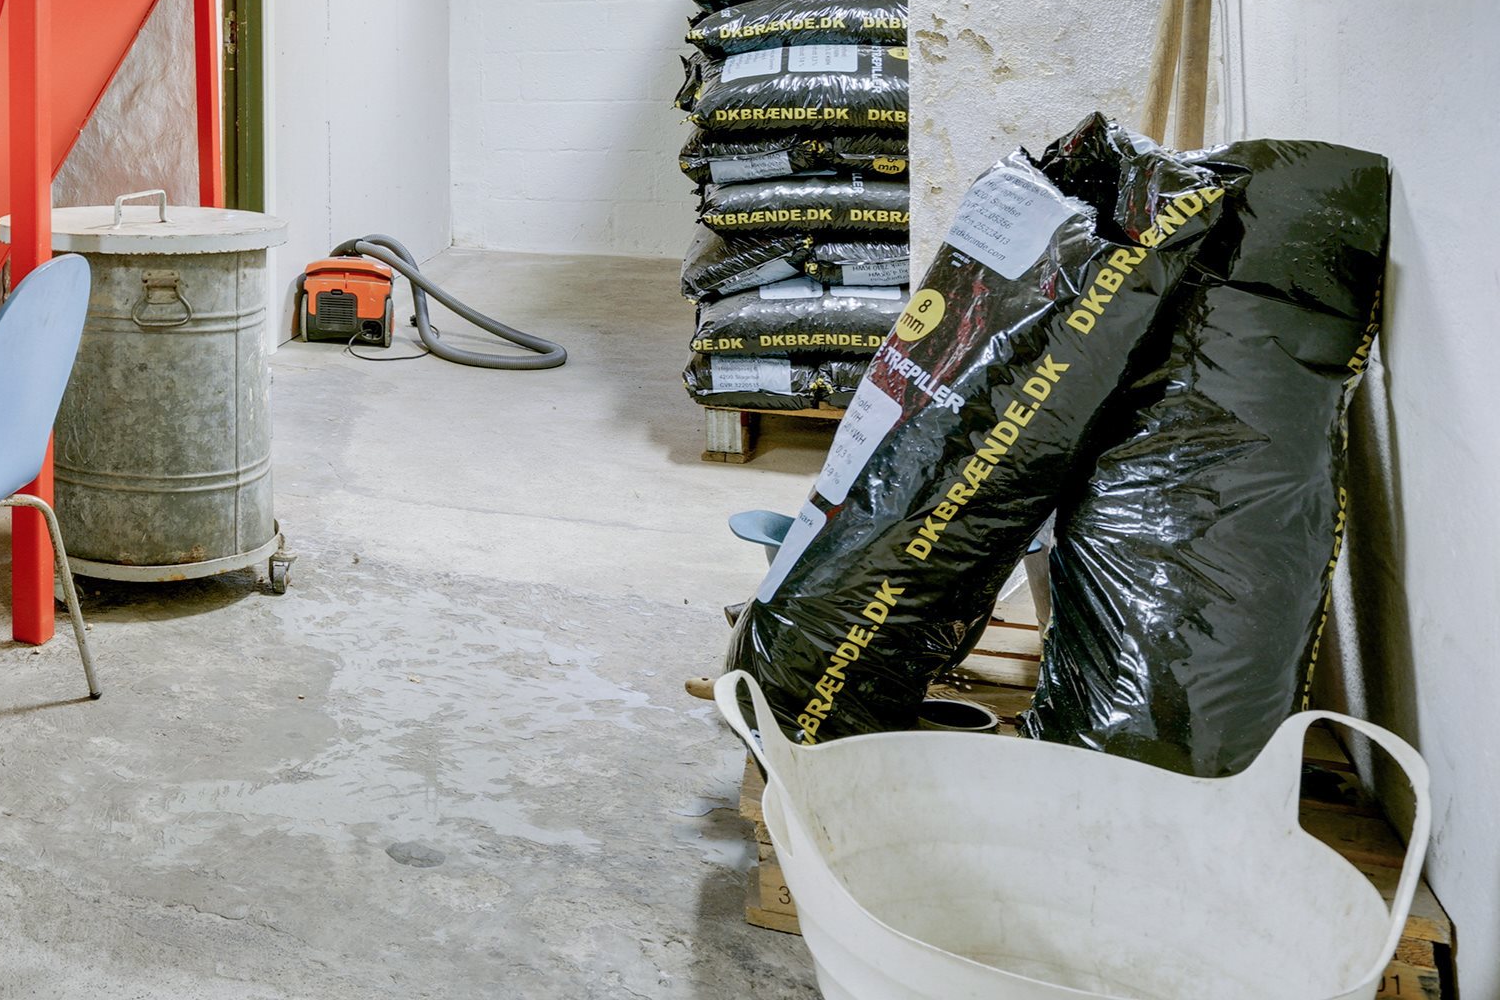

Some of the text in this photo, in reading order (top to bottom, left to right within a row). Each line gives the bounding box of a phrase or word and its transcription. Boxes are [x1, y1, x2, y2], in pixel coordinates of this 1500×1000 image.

[719, 16, 846, 40] DKBRÆNDE.DK
[715, 107, 850, 122] DKBRÆNDE.DK
[704, 208, 833, 226] DKBRÆNDE.DK
[1067, 187, 1226, 336] DKBRÆNDE
[918, 298, 933, 313] 8
[900, 312, 926, 334] mm
[880, 344, 966, 415] TRÆPILLER
[904, 354, 1071, 561] DKBRÆNDE.DK
[797, 580, 905, 745] BRÆNDE.DK
